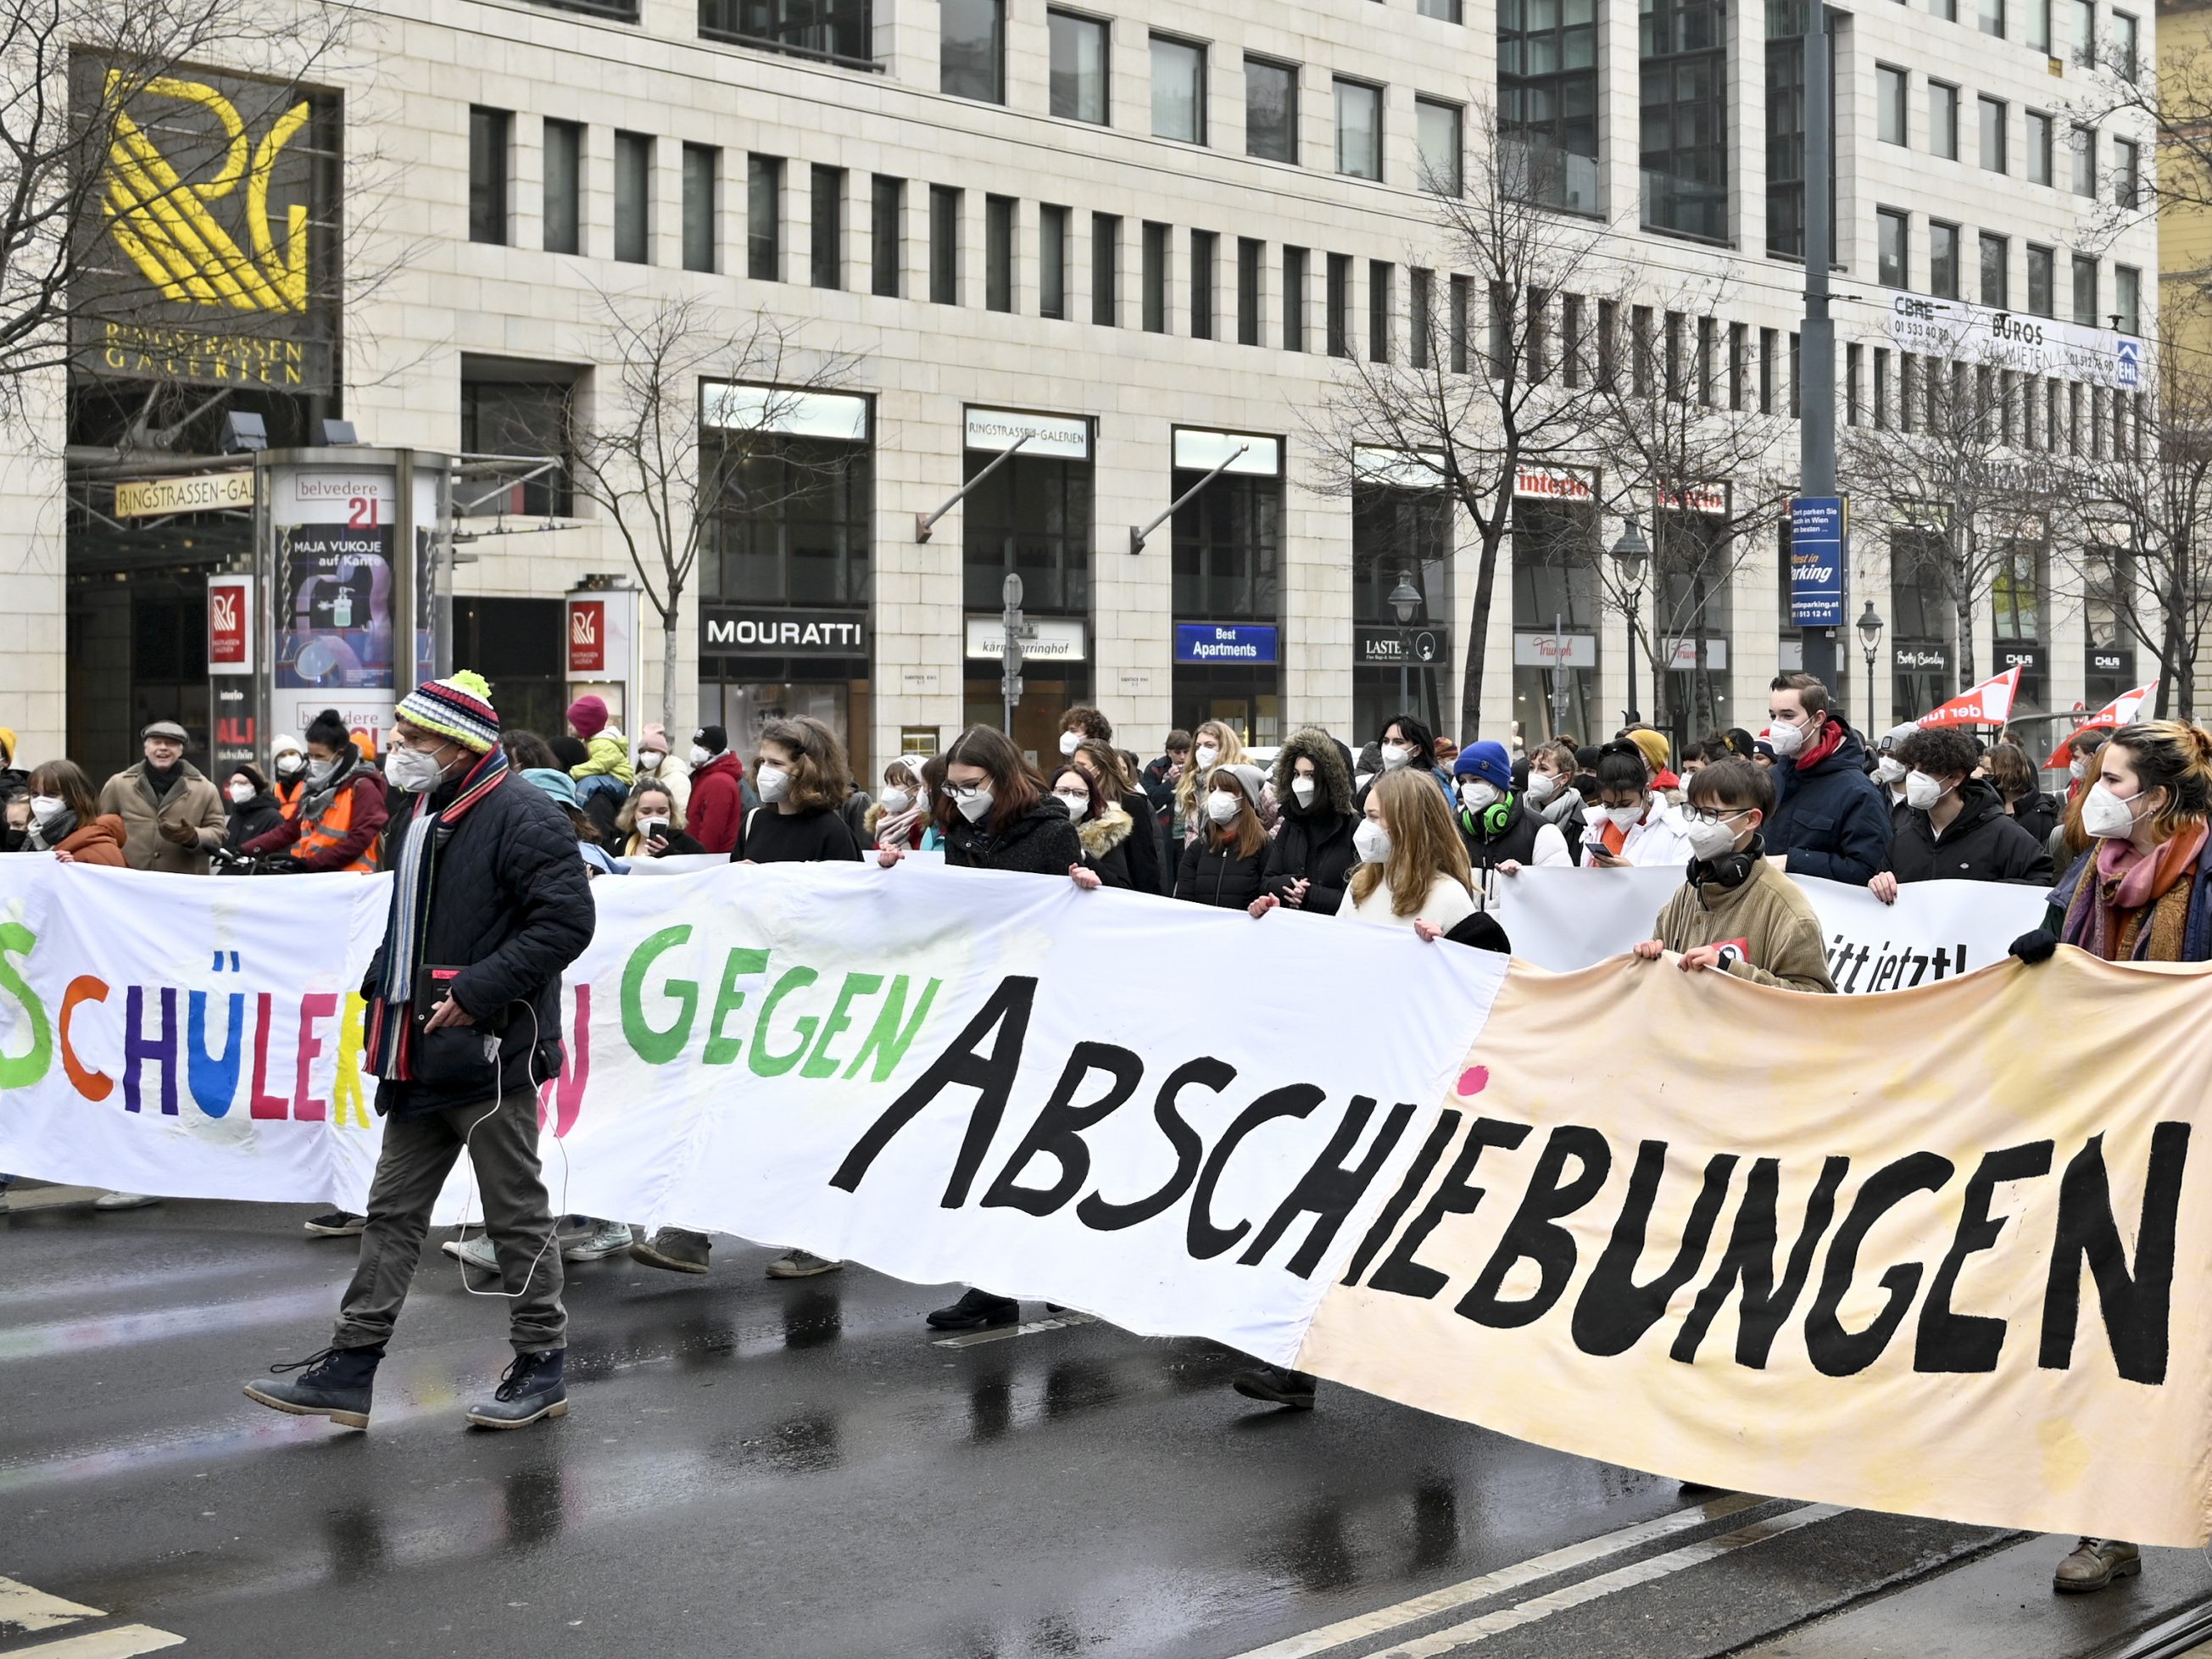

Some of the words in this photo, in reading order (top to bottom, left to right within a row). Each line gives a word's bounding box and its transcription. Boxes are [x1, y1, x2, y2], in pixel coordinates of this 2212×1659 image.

[1895, 296, 1934, 320] CBRE
[1907, 322, 1923, 337] 533
[1925, 326, 1936, 339] 40
[106, 347, 303, 384] GALERIEN
[969, 422, 1084, 443] RINGSTRASSE-GALERIEN
[301, 481, 378, 496] belvedere
[348, 498, 377, 530] 21
[294, 542, 326, 552] MAJA
[330, 541, 382, 553] VUKOJE
[319, 555, 340, 566] auf
[707, 620, 861, 645] MOURATTI
[1215, 627, 1236, 640] Best
[1192, 641, 1257, 658] Apartments
[1366, 640, 1409, 654] LASTE
[301, 710, 378, 725] bedere
[621, 924, 942, 1082] GEGEN
[829, 975, 2192, 1386] ABSCHIEBUNGEN
